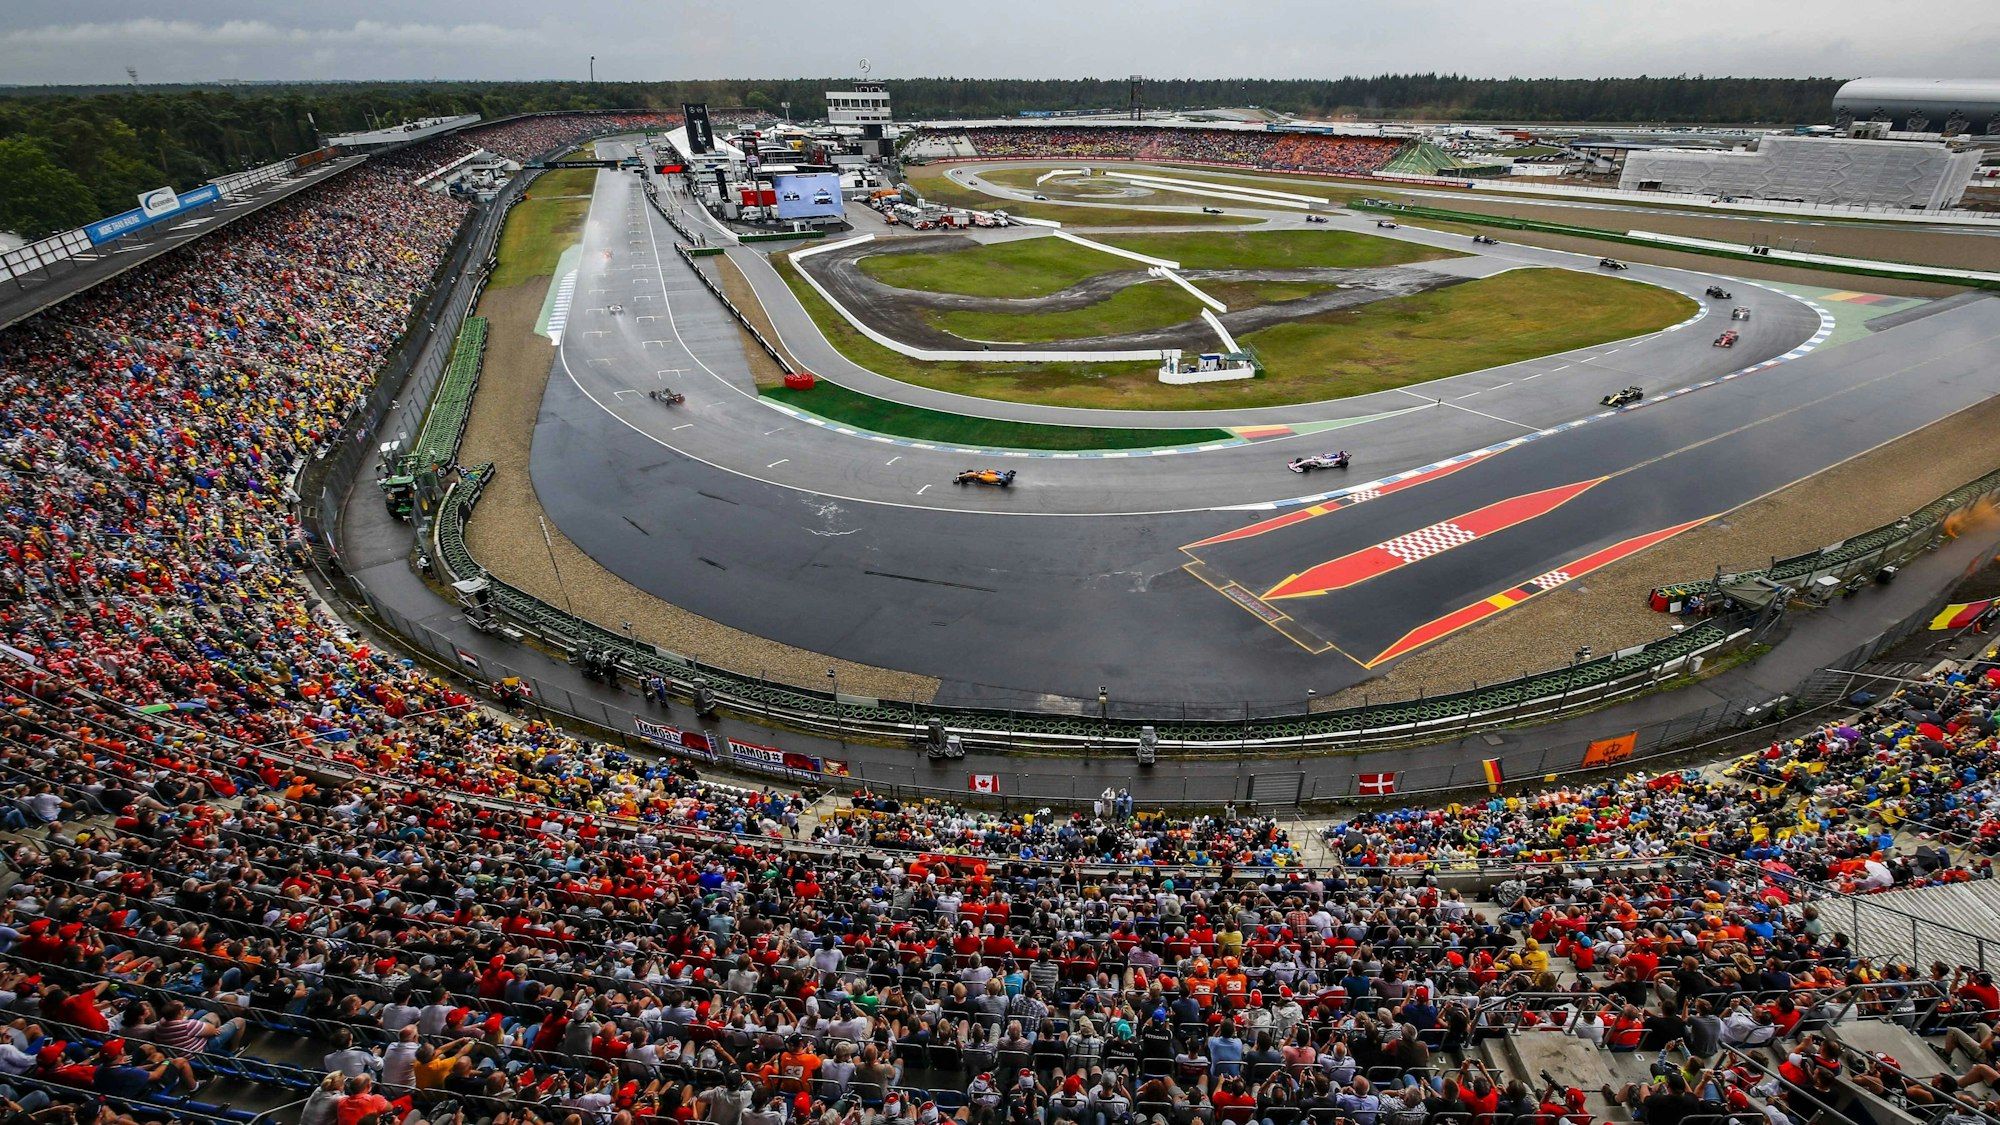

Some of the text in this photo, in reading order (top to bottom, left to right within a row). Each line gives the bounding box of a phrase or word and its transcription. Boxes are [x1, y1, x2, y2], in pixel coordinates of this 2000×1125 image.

[1226, 981, 1242, 991] 33
[1145, 1033, 1169, 1041] PETRONAS
[1111, 1049, 1135, 1057] PETRONAS
[784, 1065, 804, 1078] 33
